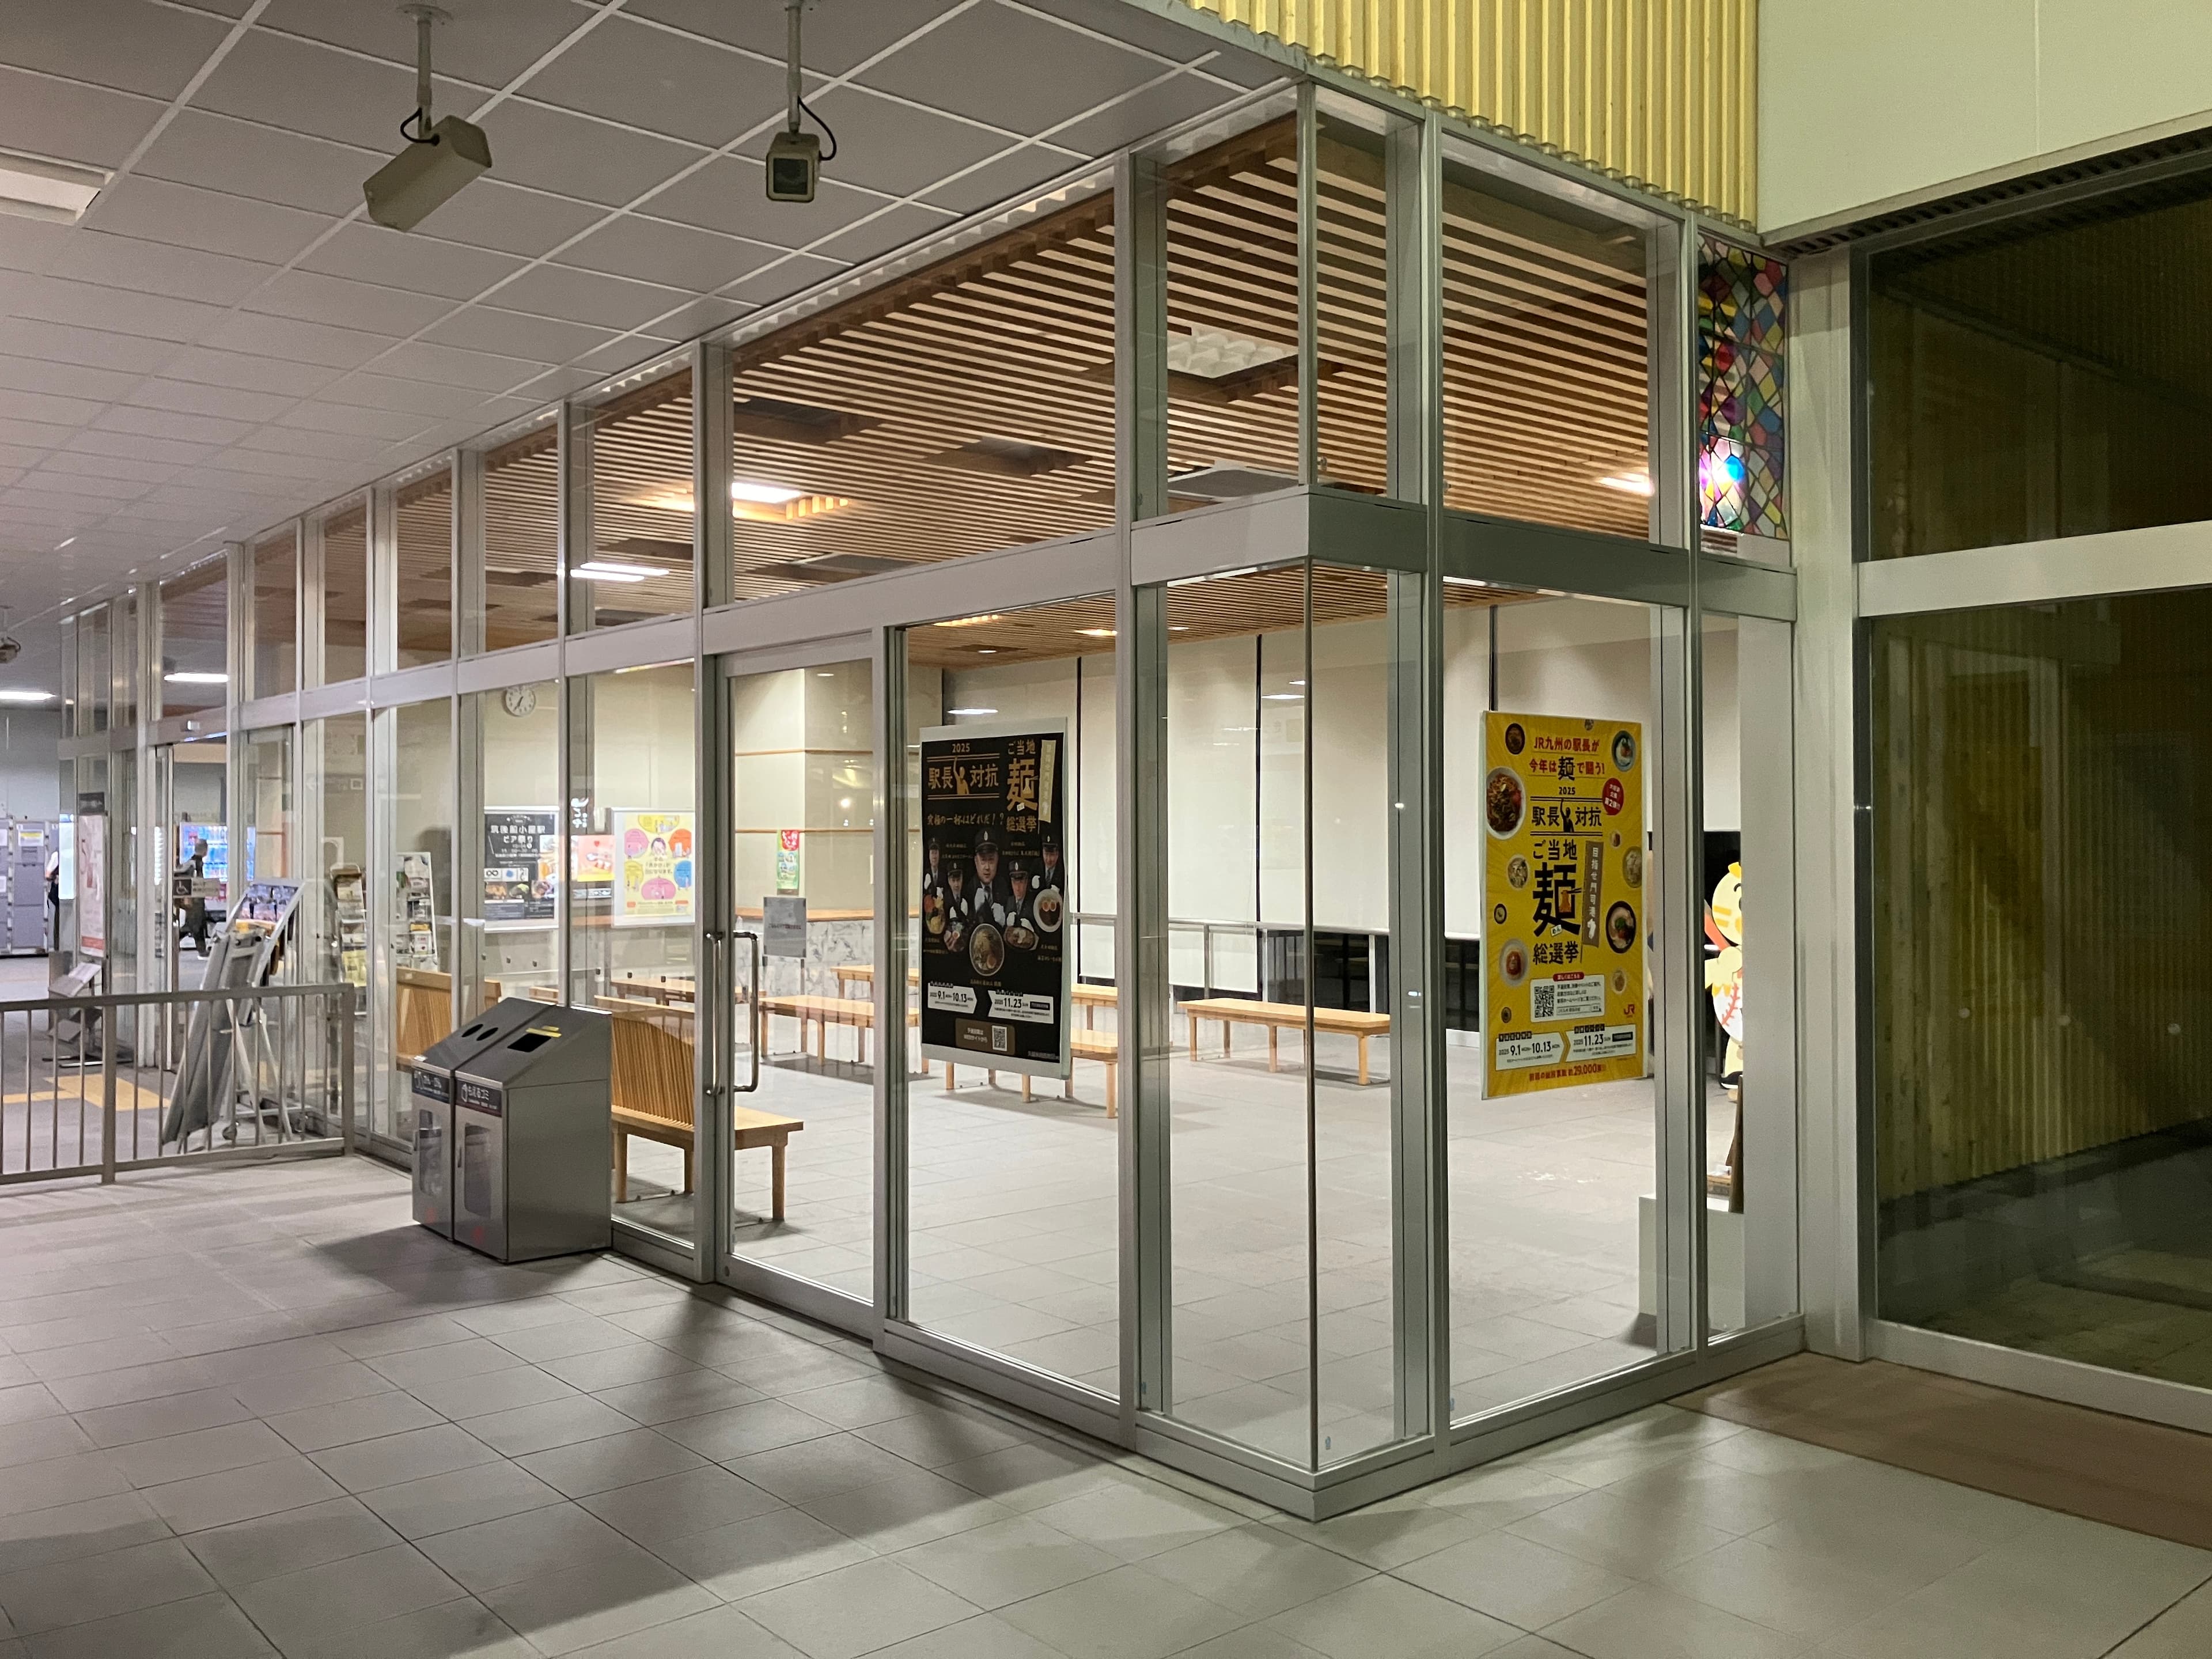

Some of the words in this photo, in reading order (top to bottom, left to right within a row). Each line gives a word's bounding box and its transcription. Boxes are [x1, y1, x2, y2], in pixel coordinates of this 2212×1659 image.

[952, 743, 971, 753] 2025
[1007, 738, 1036, 755] ご当地
[1533, 737, 1600, 752] JR九州の駅長が
[927, 766, 954, 790] 駅長
[970, 763, 999, 788] 対抗
[1007, 757, 1039, 811] 麺
[1559, 786, 1575, 795] 2025
[1006, 815, 1038, 832] 総選挙
[1531, 806, 1559, 827] 駅長
[1575, 806, 1602, 827] 対抗
[1533, 839, 1577, 861] ご当地
[1533, 862, 1581, 937] 麺
[1532, 941, 1579, 965] 総選挙
[937, 990, 945, 1000] 9.1
[952, 992, 967, 1003] 10.13
[1003, 998, 1022, 1009] 11.23
[1623, 1004, 1635, 1015] JR
[1510, 1044, 1521, 1056] 9.1
[1532, 1041, 1551, 1054] 10.13
[1584, 1035, 1604, 1047] 11.23
